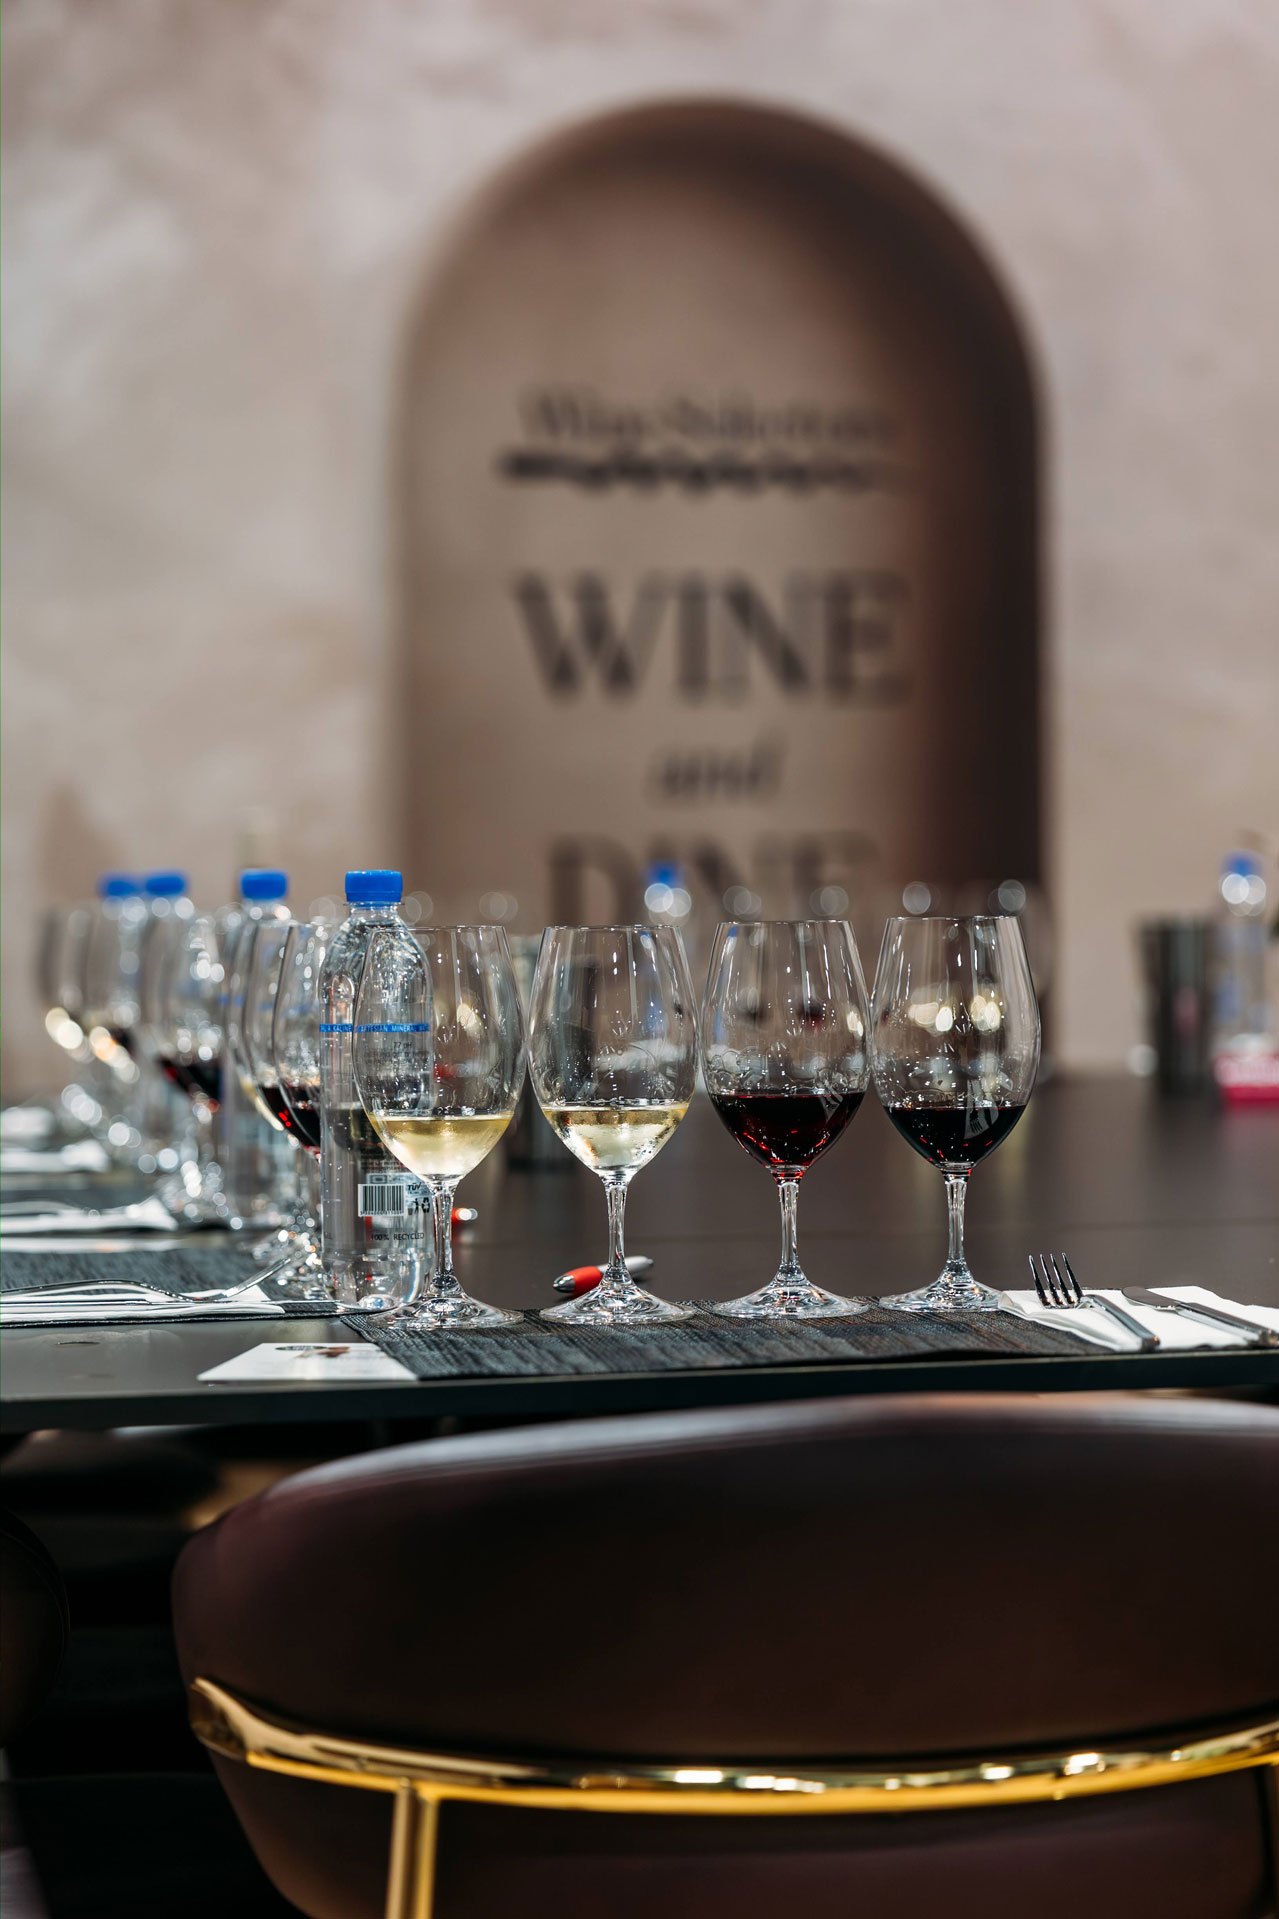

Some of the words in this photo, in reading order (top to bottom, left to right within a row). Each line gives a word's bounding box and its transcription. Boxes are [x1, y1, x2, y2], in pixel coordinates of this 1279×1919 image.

[514, 570, 908, 706] WINE
[650, 735, 784, 802] and
[545, 833, 878, 925] DNE
[407, 1182, 421, 1191] TÜV
[371, 1233, 390, 1241] 100%
[393, 1232, 425, 1241] RECYCLED
